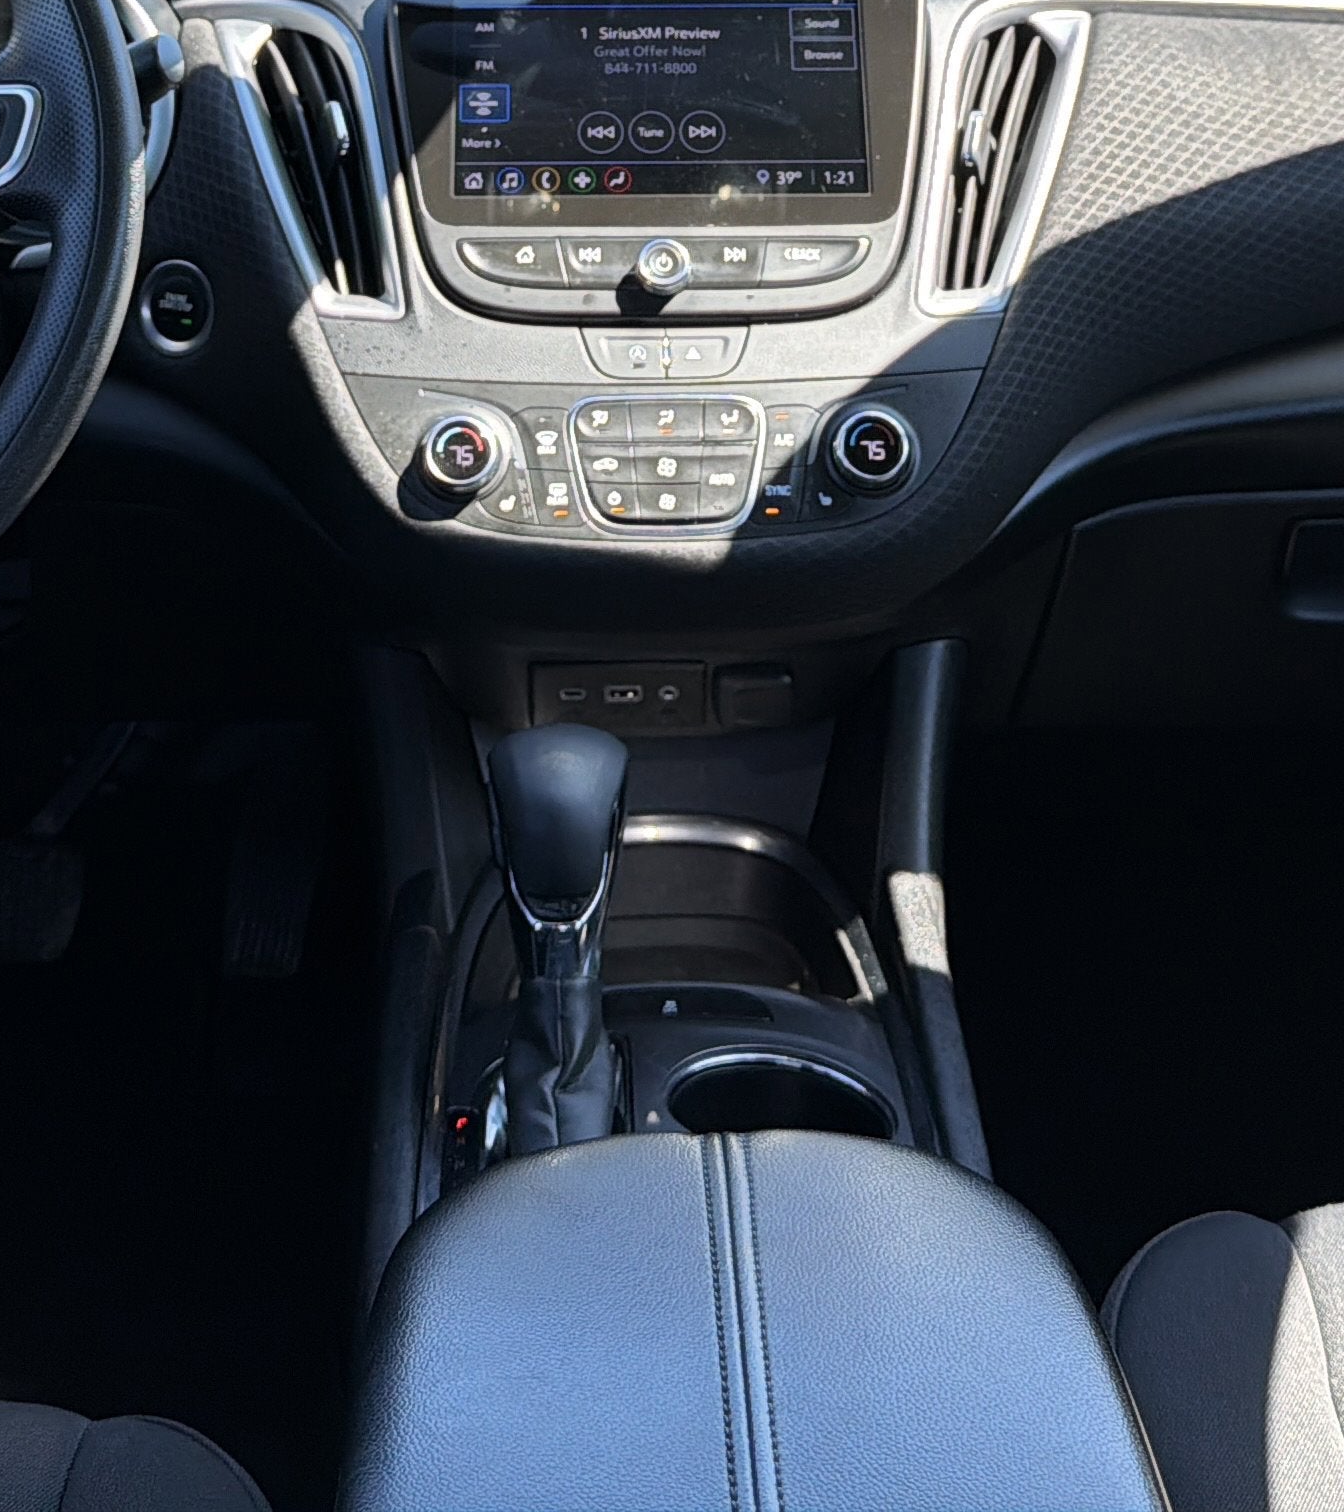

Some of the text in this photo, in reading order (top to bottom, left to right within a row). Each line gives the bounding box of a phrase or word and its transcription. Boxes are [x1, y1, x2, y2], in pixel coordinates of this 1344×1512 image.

[475, 22, 494, 32] AM
[804, 17, 840, 29] Sound
[580, 26, 721, 40] 1 SiriusXM Preview
[593, 44, 706, 58] Great Offer Now!
[804, 49, 844, 61] Browse
[475, 60, 494, 71] FM
[604, 62, 697, 75] 844-711-8800
[637, 126, 665, 138] Tune
[462, 138, 492, 149] More
[823, 171, 855, 185] 1:21
[448, 444, 474, 468] 75
[859, 440, 886, 462] 75
[765, 484, 792, 497] SYNC
